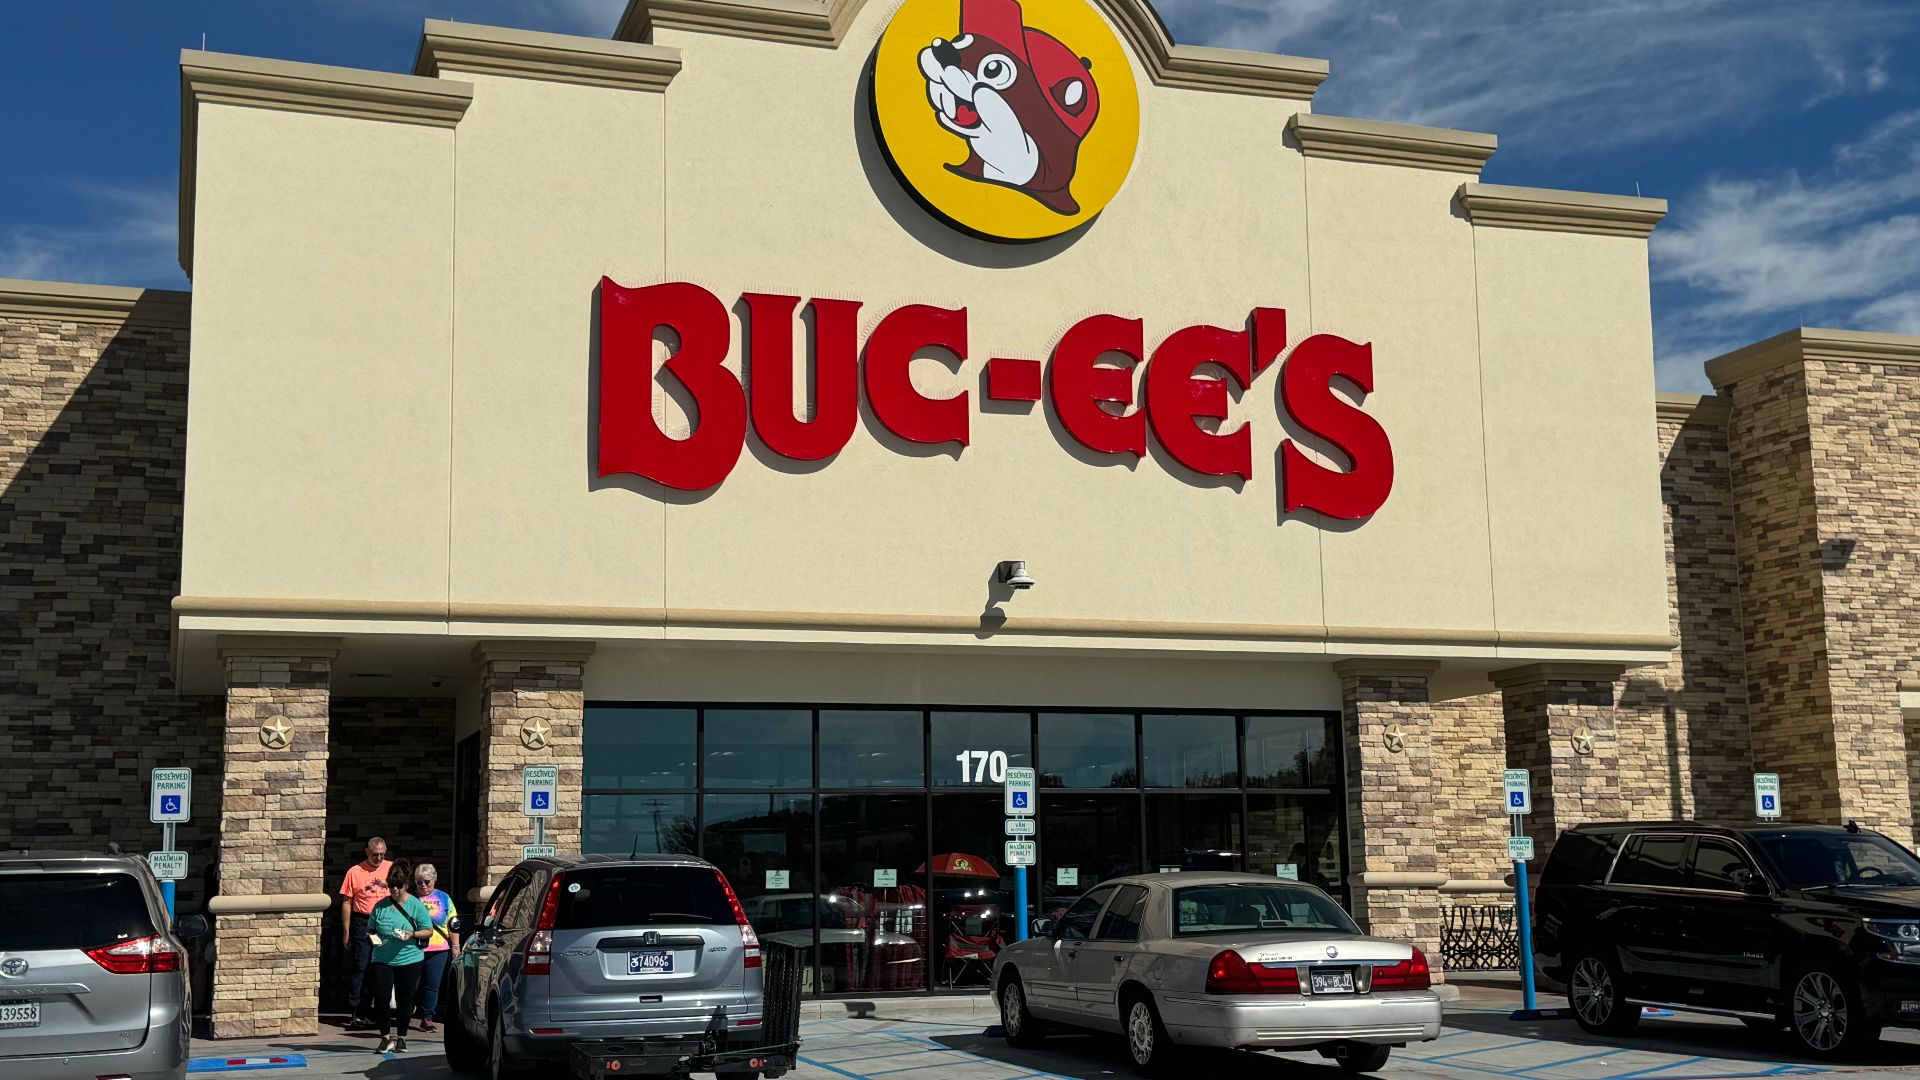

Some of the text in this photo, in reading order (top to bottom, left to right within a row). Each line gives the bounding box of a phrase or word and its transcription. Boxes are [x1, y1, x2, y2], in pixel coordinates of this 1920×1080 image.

[597, 275, 1394, 520] BUC-EE'S
[956, 750, 1008, 783] 170
[155, 772, 188, 780] RESERVED
[156, 782, 186, 790] PARKING
[639, 955, 665, 967] 74096
[1313, 976, 1328, 988] 394
